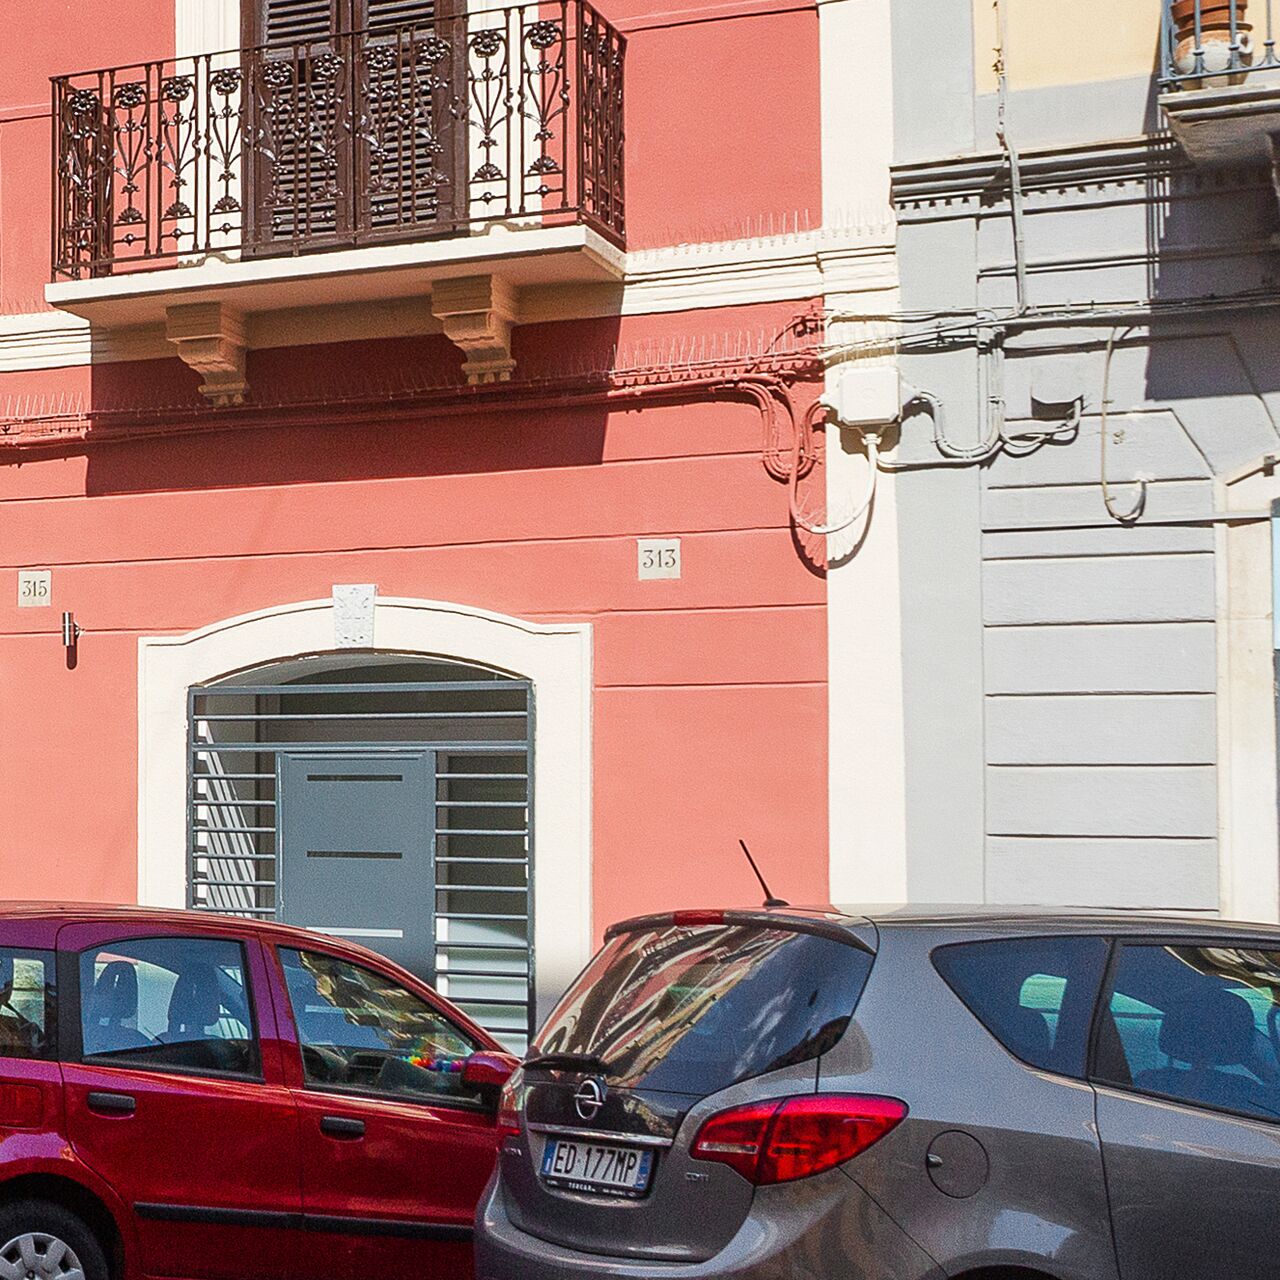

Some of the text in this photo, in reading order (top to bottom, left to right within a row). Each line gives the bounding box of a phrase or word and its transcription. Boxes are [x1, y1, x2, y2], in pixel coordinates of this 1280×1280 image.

[642, 548, 676, 569] 313
[22, 580, 48, 597] 315
[552, 1142, 638, 1184] ED 177MP
